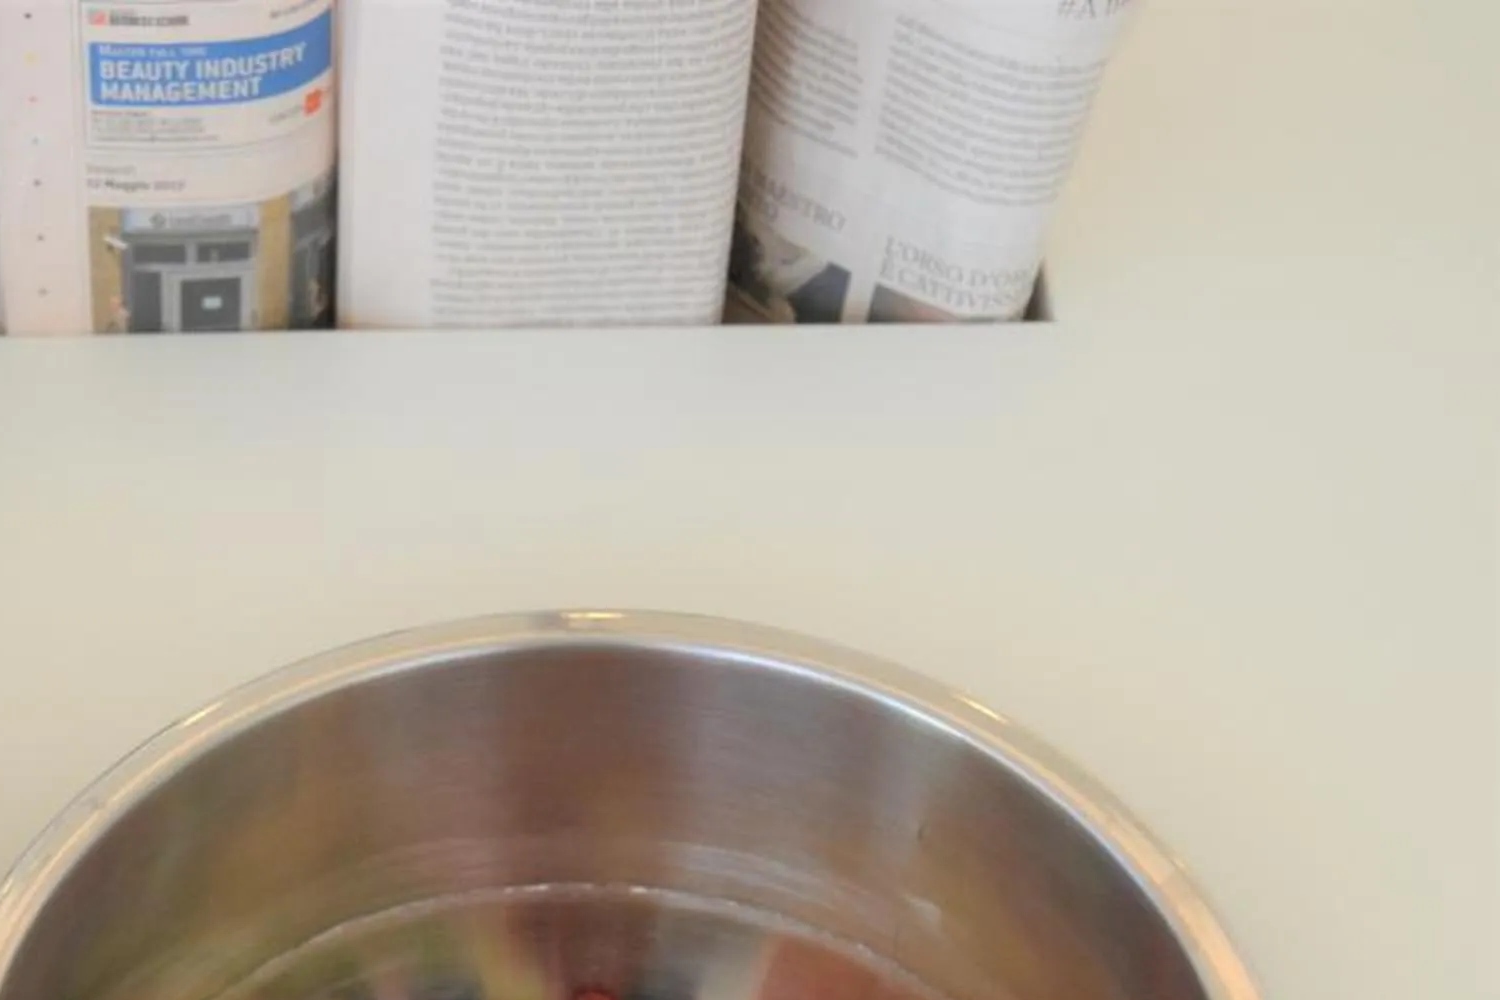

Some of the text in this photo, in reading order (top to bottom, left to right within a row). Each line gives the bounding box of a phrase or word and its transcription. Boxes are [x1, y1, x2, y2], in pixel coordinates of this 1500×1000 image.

[99, 41, 308, 81] BEAUTY INDUSTRY
[100, 75, 264, 103] MANAGEMENT
